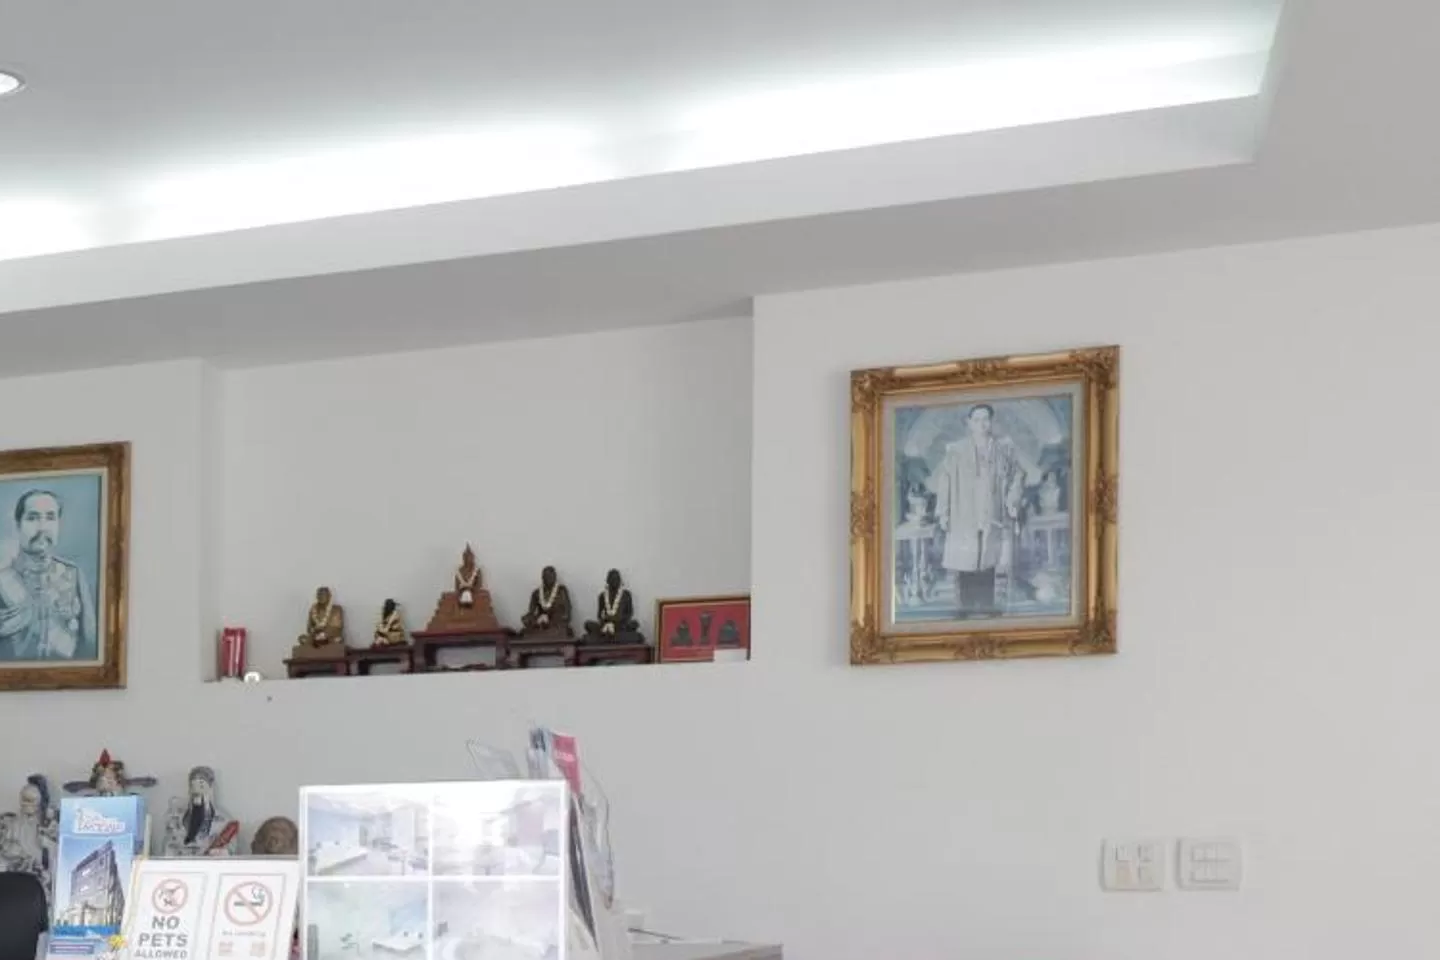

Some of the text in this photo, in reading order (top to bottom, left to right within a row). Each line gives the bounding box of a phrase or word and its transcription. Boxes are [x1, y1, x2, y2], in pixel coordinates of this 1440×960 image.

[151, 915, 181, 930] NO
[138, 932, 189, 948] PETS
[133, 949, 188, 960] ALLOWED
